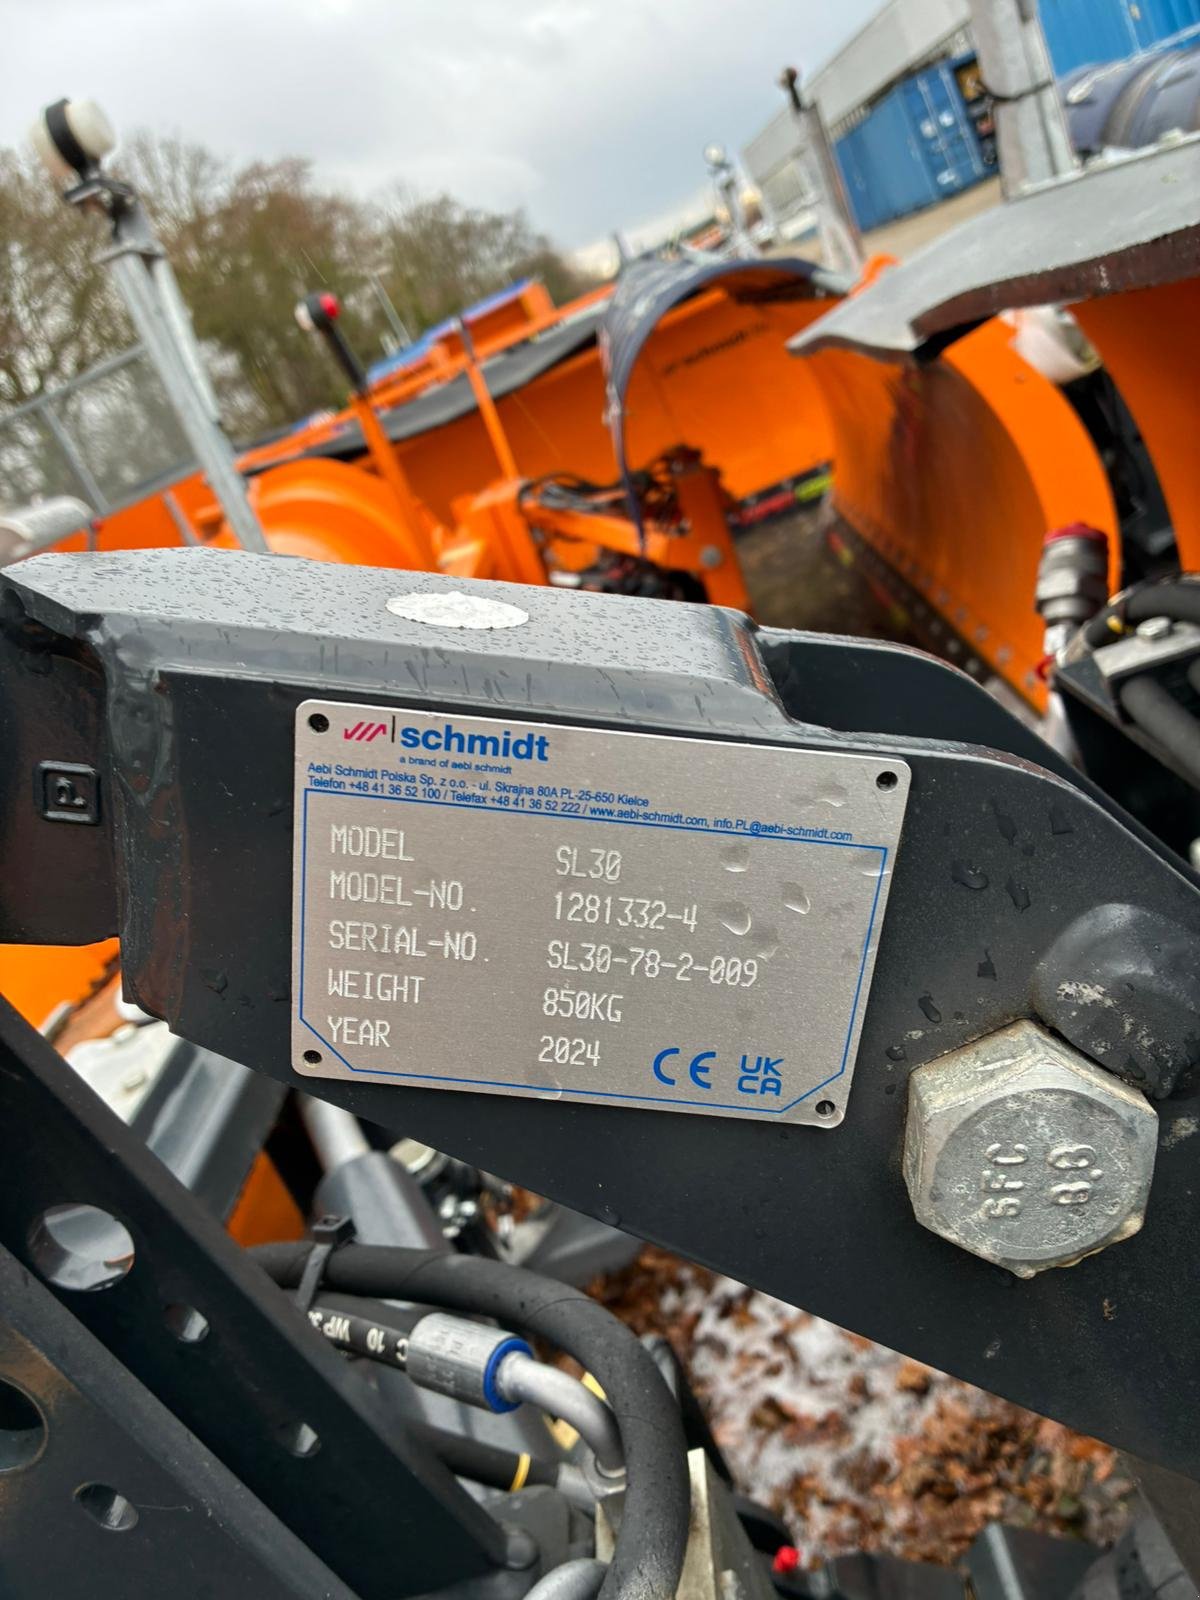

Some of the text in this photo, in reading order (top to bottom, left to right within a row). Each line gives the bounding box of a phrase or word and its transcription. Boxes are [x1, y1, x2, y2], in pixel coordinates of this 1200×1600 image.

[400, 724, 550, 762] schmidt
[399, 756, 513, 775] a brand of aebi schmidt
[307, 762, 332, 775] Aebi
[335, 764, 378, 780] Schmidt
[380, 769, 416, 784] Polska
[419, 773, 437, 787] Sp.
[440, 778, 447, 786] z
[449, 780, 469, 789] o.o.
[479, 781, 491, 792] ul.
[494, 781, 534, 798] Skrajna
[537, 785, 558, 798] 80A
[560, 788, 615, 804] PL-25-650
[617, 793, 650, 807] Kielce
[308, 775, 346, 790] Telefon
[349, 781, 369, 792] +48
[371, 782, 385, 794] 41
[388, 784, 402, 796] 36
[404, 785, 418, 798] 52
[422, 788, 441, 800] 100
[450, 790, 487, 804] Telefax
[490, 795, 510, 806] +48
[512, 796, 525, 808] 41
[528, 799, 542, 810] 36
[544, 800, 558, 812] 52
[560, 802, 580, 813] 222
[589, 807, 710, 829] www.aebi-schmidt.com,
[713, 817, 853, 841] info.PL@aebi-schmidt.com
[331, 824, 415, 862] MODEL
[555, 845, 622, 881] SL30
[330, 870, 477, 912] MODEL-NO.
[554, 891, 698, 933] 1281332-4
[329, 920, 489, 963] SERIAL-NO.
[546, 940, 758, 987] SL30-78-2-009
[328, 968, 426, 1004] WEIGHT
[543, 987, 624, 1023] 850KG
[327, 1015, 391, 1048] YEAR
[537, 1035, 601, 1067] 2024
[653, 1047, 717, 1090] CE
[740, 1054, 784, 1077] UK
[737, 1075, 782, 1097] CA
[323, 1315, 351, 1343] WP
[366, 1327, 386, 1353] 10
